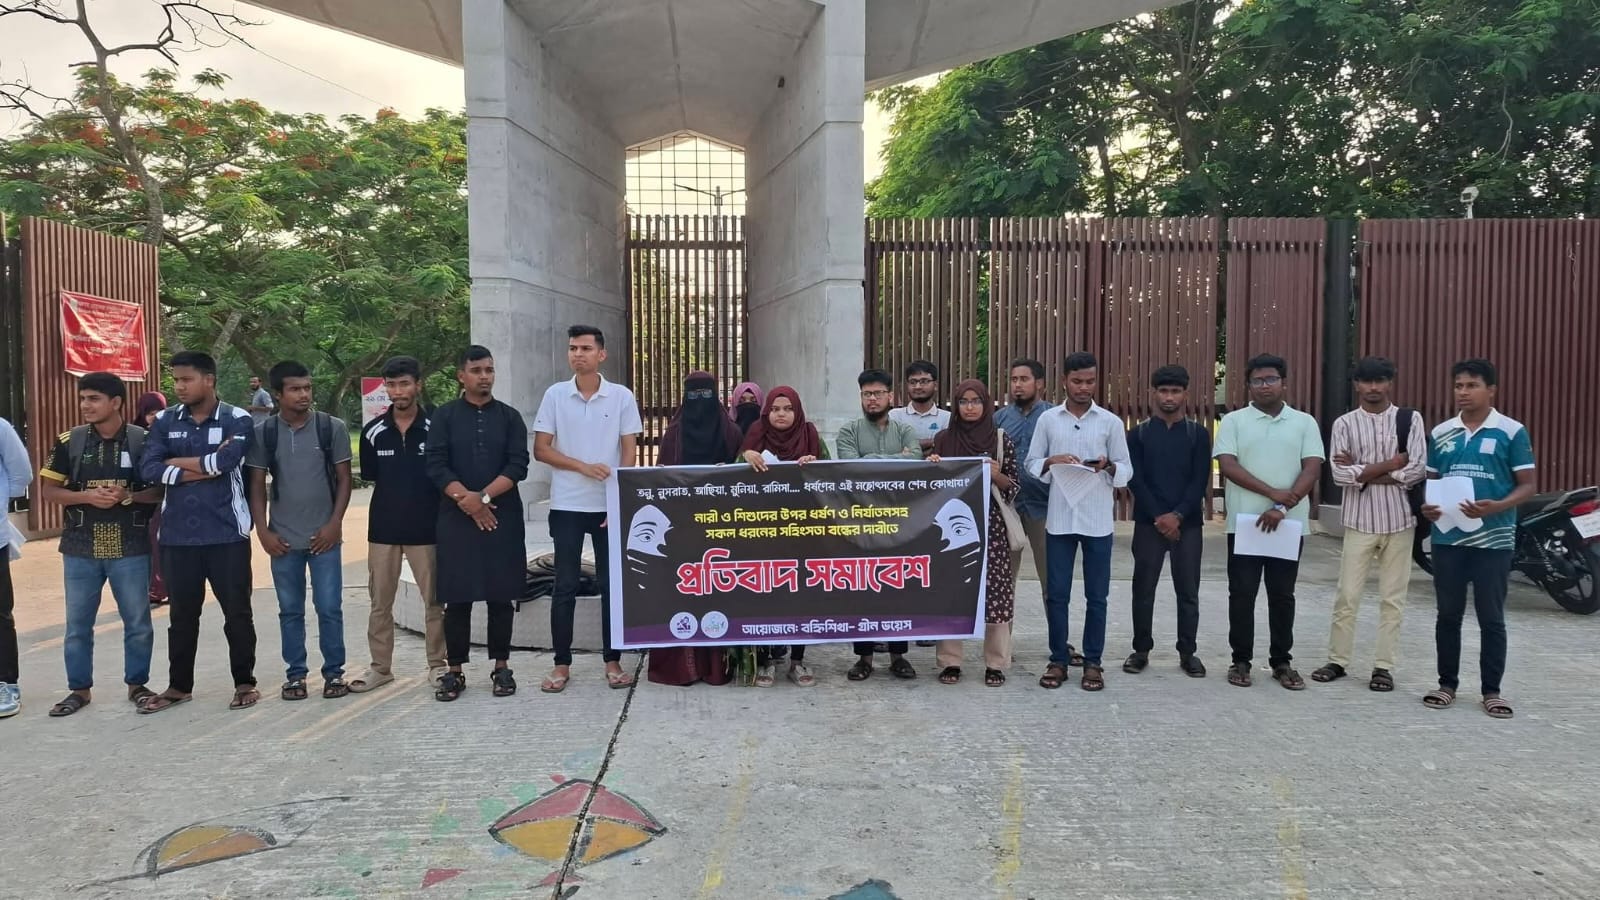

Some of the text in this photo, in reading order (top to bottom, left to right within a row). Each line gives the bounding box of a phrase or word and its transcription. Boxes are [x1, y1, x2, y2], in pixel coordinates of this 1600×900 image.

[657, 487, 691, 500] নুসরাত,
[730, 482, 759, 497] মুনিয়া,
[804, 480, 835, 492] ধর্ষণের
[838, 480, 853, 492] এই
[855, 480, 905, 491] মহোৎসবের
[908, 480, 927, 490] শেষ
[930, 478, 970, 490] কোথায়?
[694, 504, 909, 523] নারী ও শিশুদের উপর ধর্ষণ ও নির্যাতনসহ
[706, 520, 899, 540] সকল ধরনের সহিংসতা বন্ধের দাবীতে
[676, 547, 931, 596] প্রতিবাদ সমাবেশ
[857, 617, 879, 632] গ্রীন
[881, 618, 912, 631] ভয়েস
